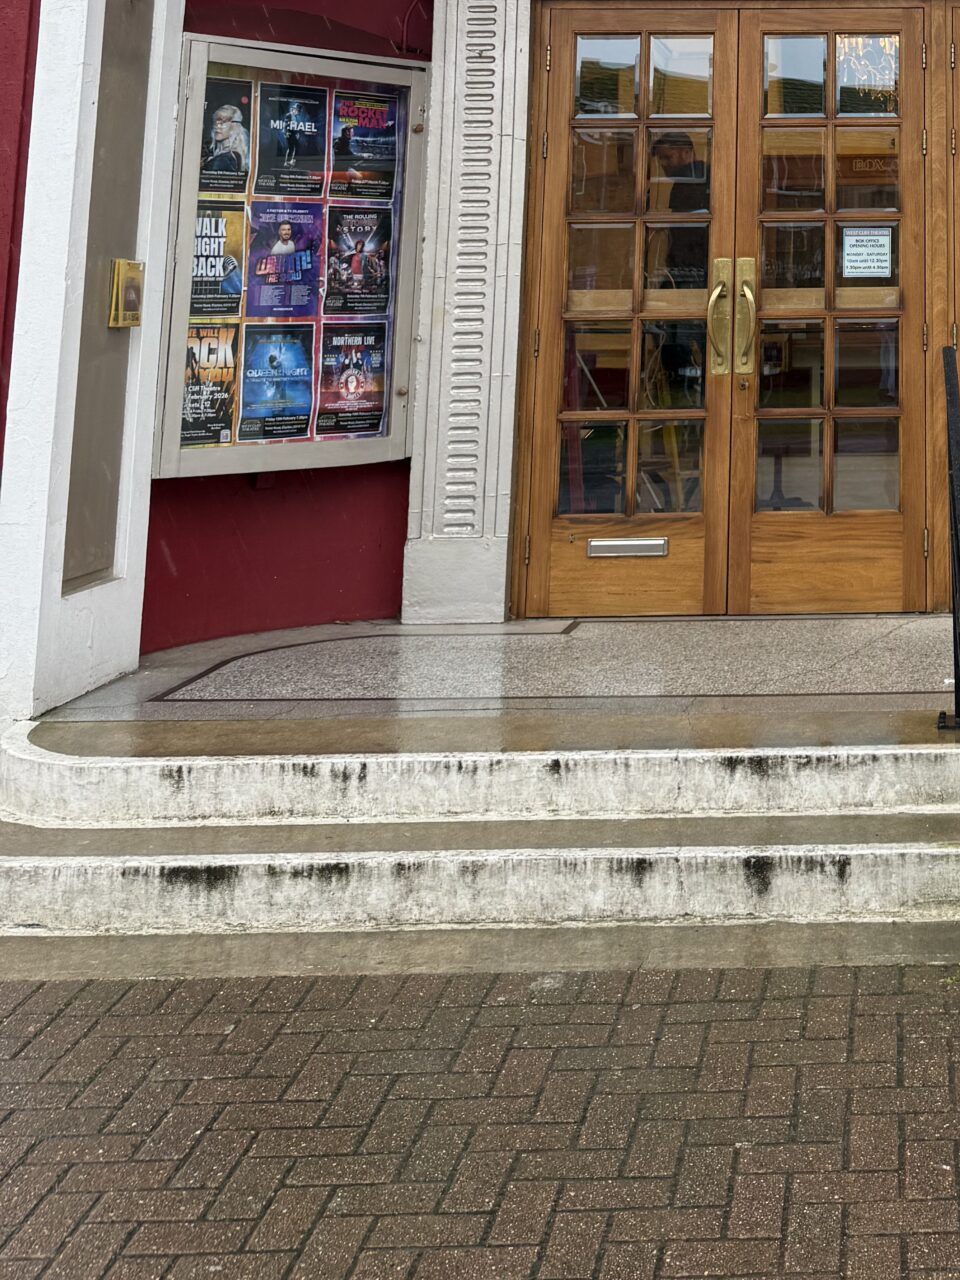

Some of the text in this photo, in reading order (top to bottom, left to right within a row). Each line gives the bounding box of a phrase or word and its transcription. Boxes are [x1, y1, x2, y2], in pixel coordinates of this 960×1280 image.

[339, 106, 388, 118] ROCKET
[270, 120, 317, 132] MICHAEL
[192, 256, 224, 276] BACK
[332, 336, 375, 346] NORTHERN LIVE
[187, 328, 235, 368] OCK
[247, 368, 307, 377] QUEEN NIGHT
